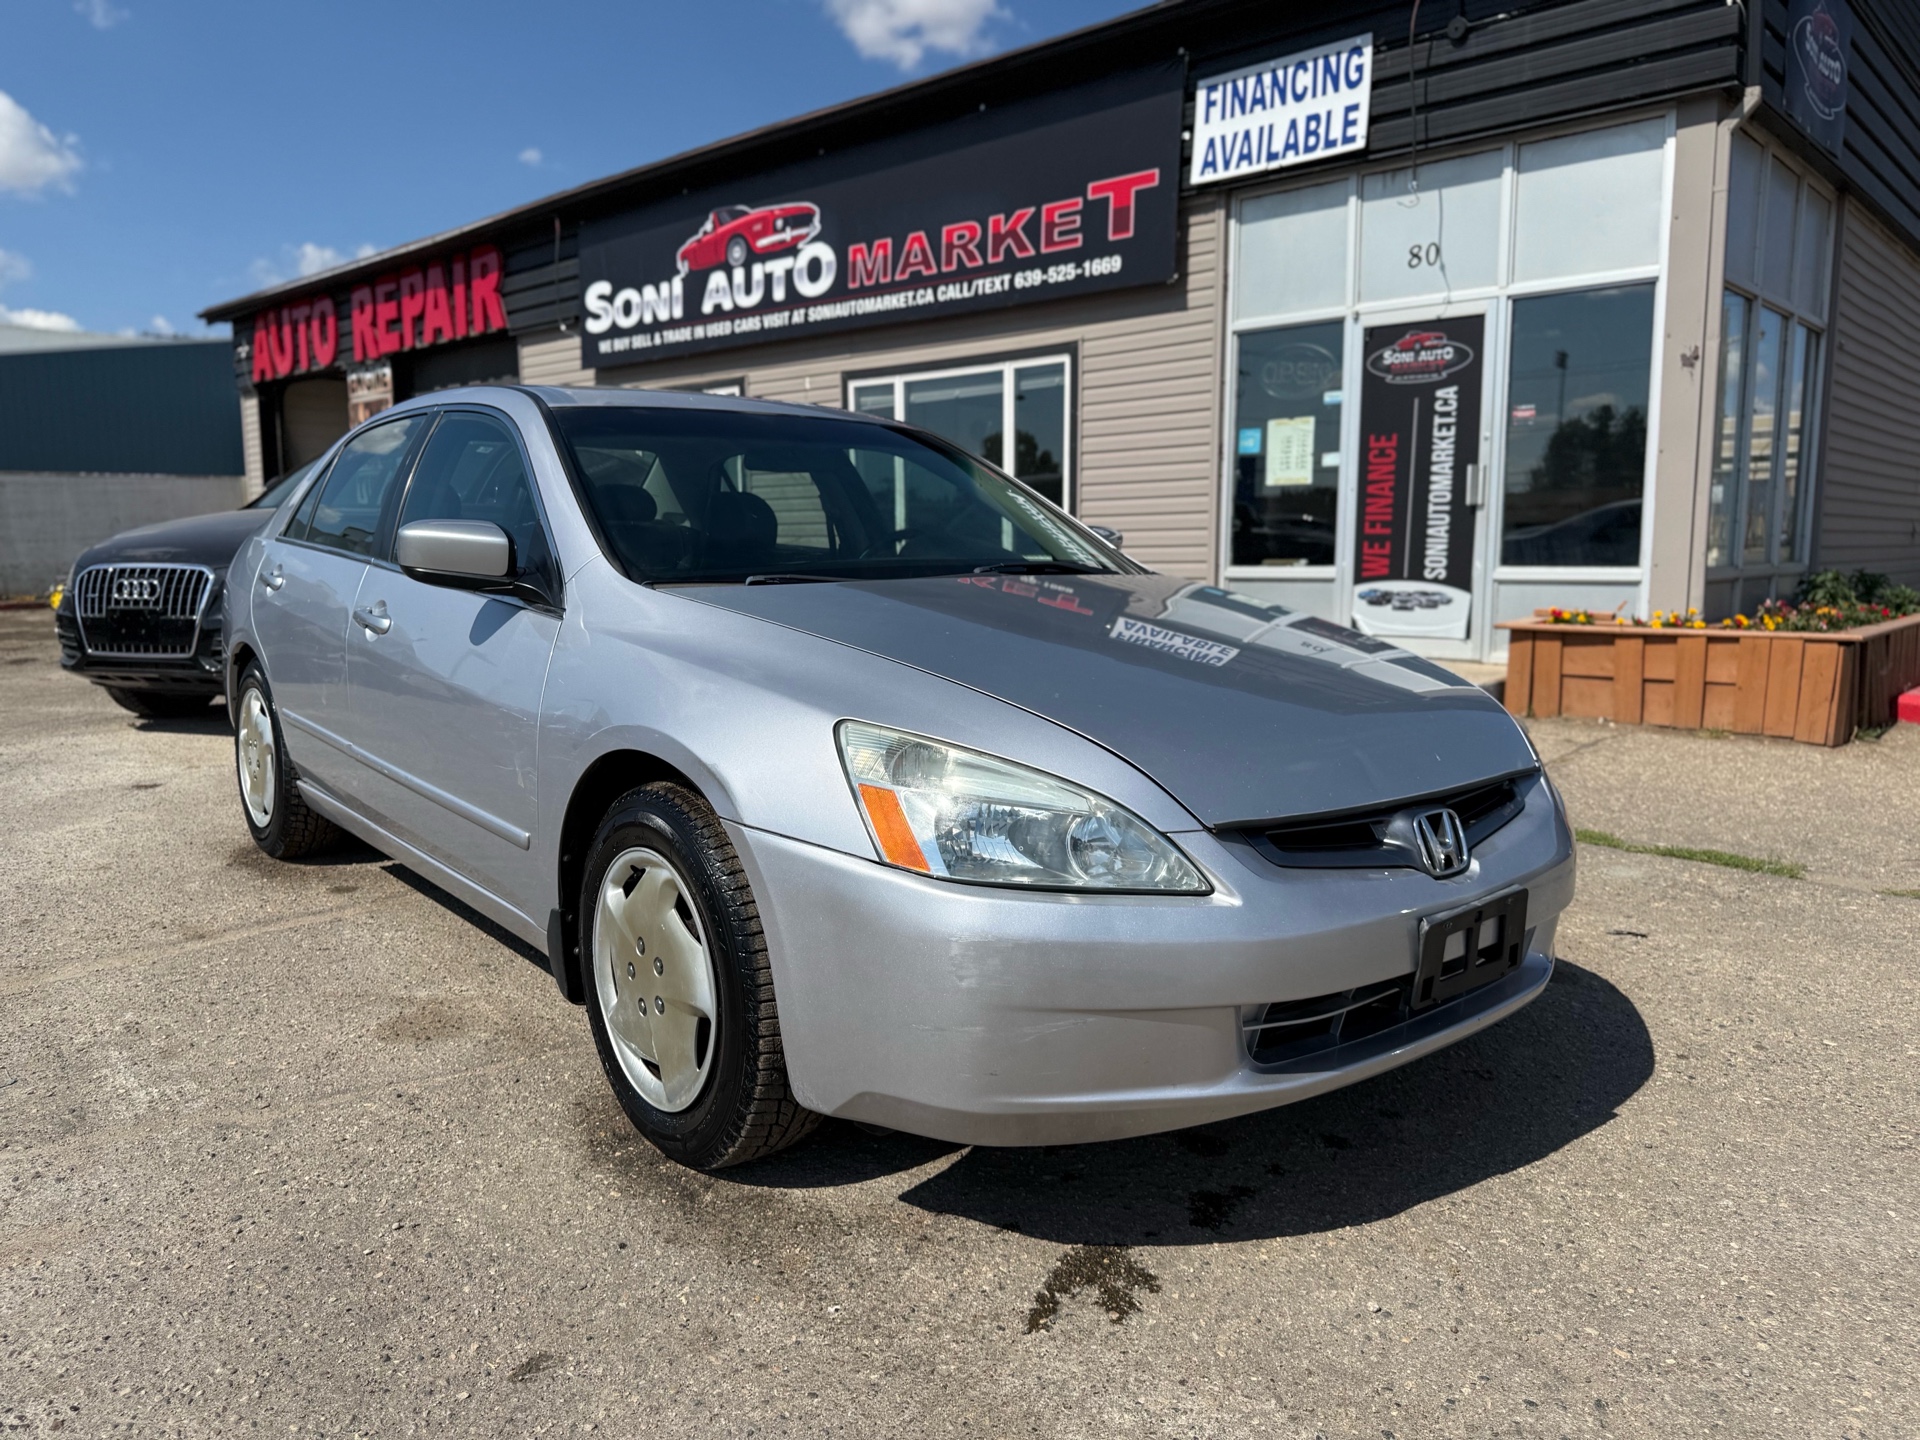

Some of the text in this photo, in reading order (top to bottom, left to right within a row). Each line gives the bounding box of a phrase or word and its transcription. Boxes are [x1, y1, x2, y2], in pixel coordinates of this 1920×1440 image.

[1204, 45, 1365, 124] FINANCING
[1818, 51, 1842, 85] AUTO
[1199, 102, 1361, 176] AVAILABLE
[584, 168, 1160, 334] SONI AUTO MARKET
[1407, 242, 1440, 268] 80
[252, 245, 506, 383] AUTO REPAIR
[598, 254, 1123, 354] WE BUY SELL & TRADE IN USED CARS VISIT AT SONIAUTOMARKET.CA CALL/TEXT 639-525-1669
[1382, 346, 1454, 365] SONI AUTO
[1361, 432, 1398, 578] WE FINANCE
[1424, 385, 1459, 580] SONIAUTOMARKET.CA
